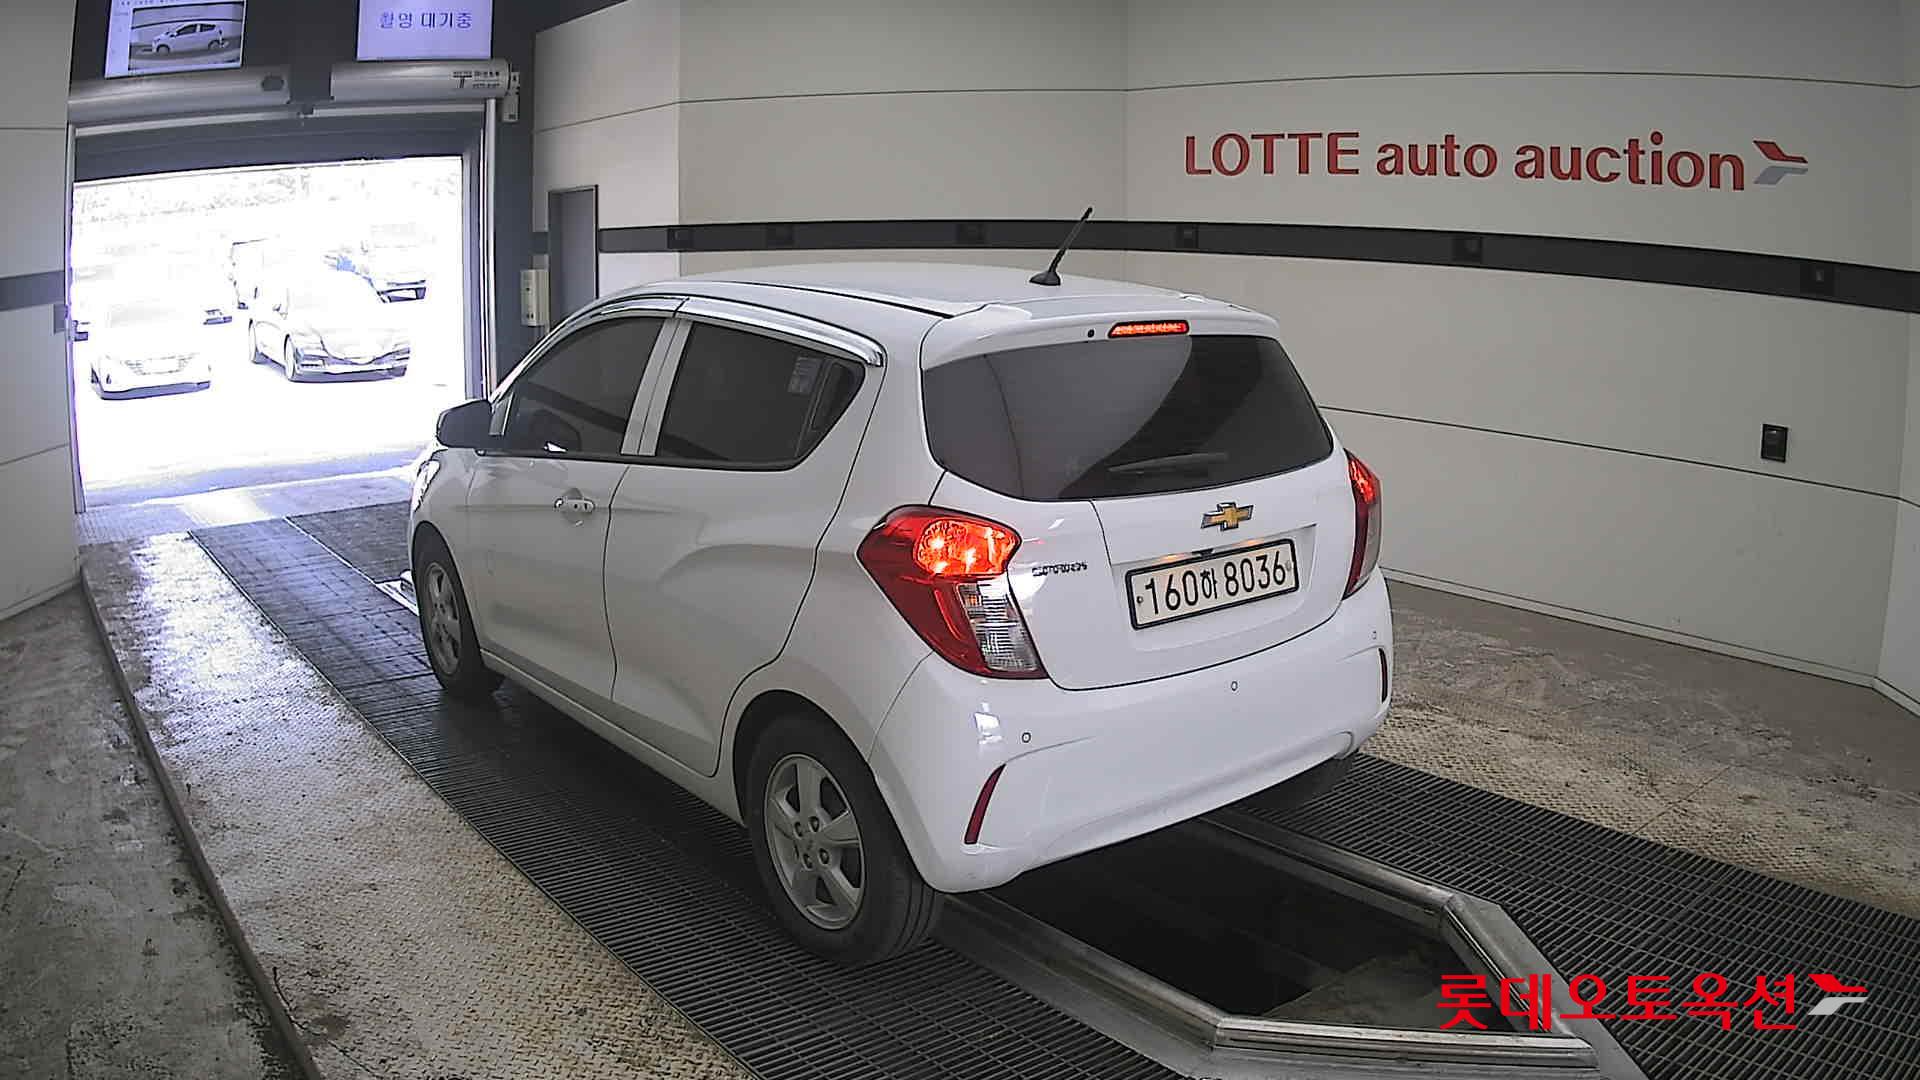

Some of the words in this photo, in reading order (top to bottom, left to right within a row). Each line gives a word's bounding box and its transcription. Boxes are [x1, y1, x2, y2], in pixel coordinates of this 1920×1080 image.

[421, 11, 472, 30] 대기중
[1185, 132, 1360, 176] LOTTE
[1376, 134, 1498, 178] auto
[1514, 131, 1745, 191] auction
[1145, 568, 1218, 614] 160하
[1224, 550, 1286, 595] 8036
